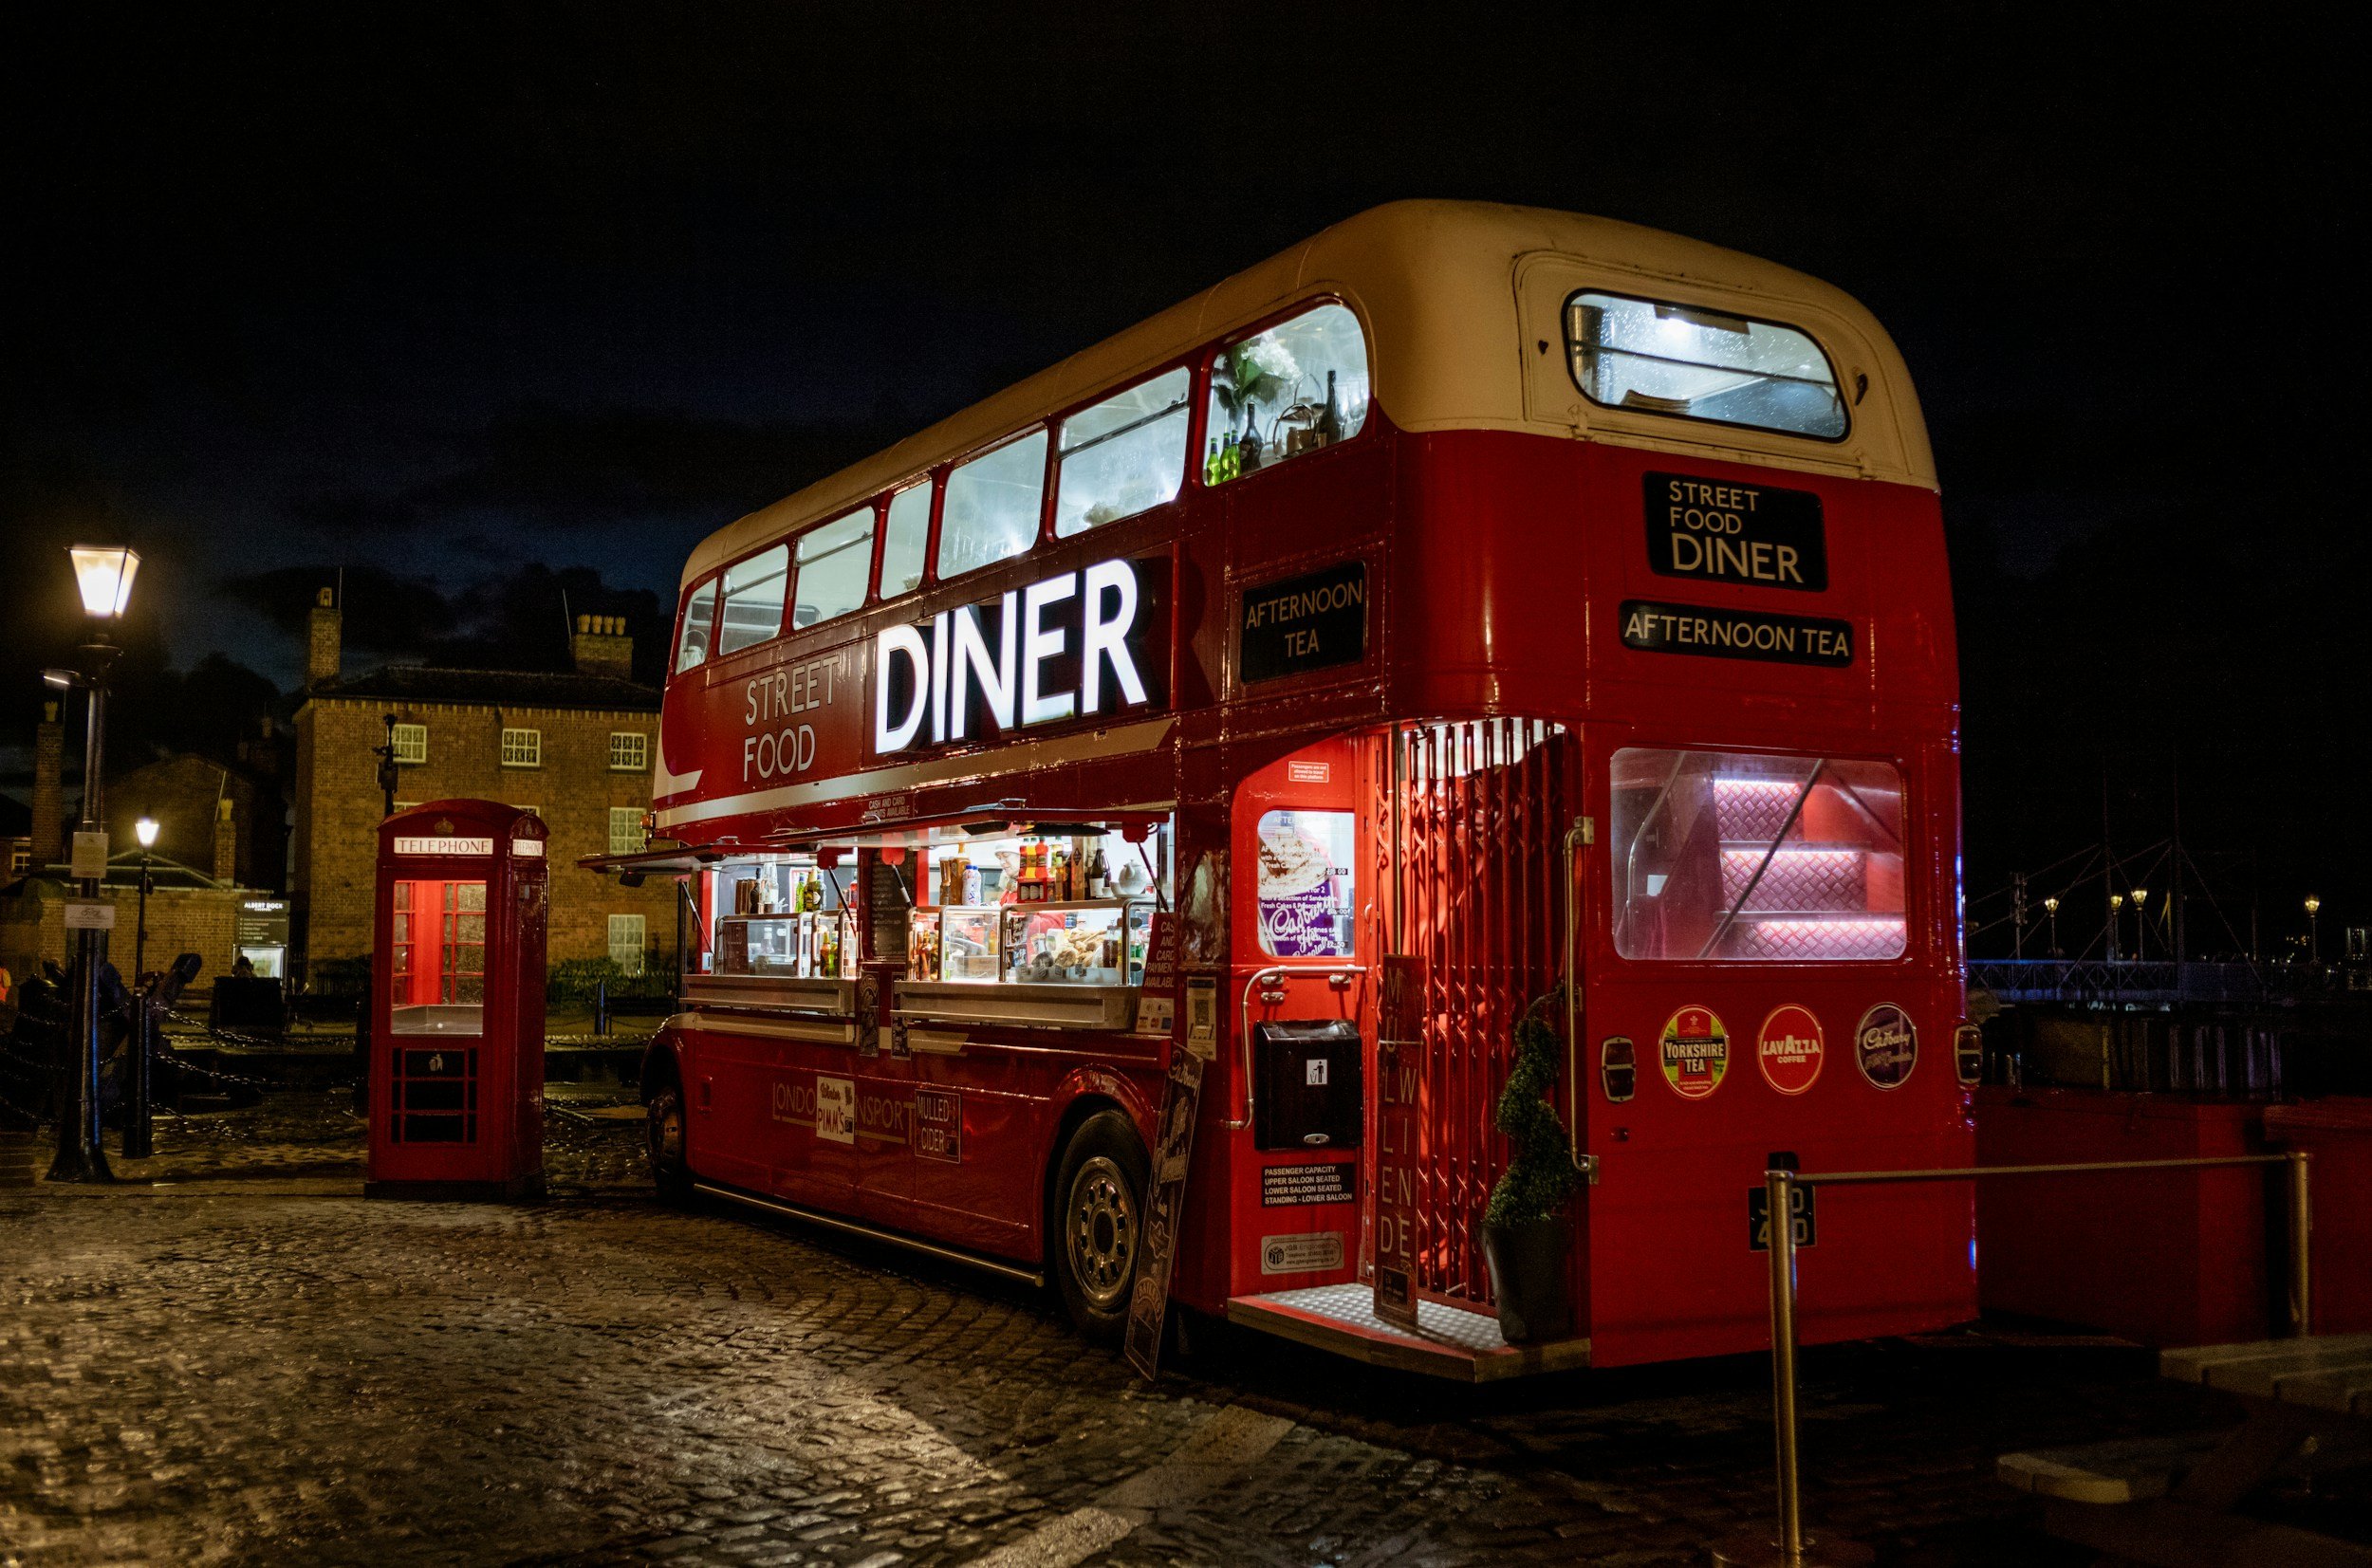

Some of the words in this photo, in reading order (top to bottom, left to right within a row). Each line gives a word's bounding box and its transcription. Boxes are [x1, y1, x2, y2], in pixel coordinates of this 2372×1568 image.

[1669, 480, 1760, 512] STREET
[1669, 507, 1742, 535] FOOD
[1671, 532, 1805, 584] DINER
[1246, 579, 1362, 630] AFTERNOON
[1285, 628, 1320, 658] TEA
[1624, 613, 1796, 652] AFTERNOON
[1802, 628, 1850, 657] TEA
[875, 558, 1148, 755] DINER
[745, 655, 840, 727] STREET
[743, 724, 816, 784] FOOD
[398, 840, 490, 854] TELEPHONE
[513, 840, 542, 855] TELEPHONE
[1665, 1042, 1725, 1059] YORKSHIRE
[1762, 1034, 1821, 1056] LAVAZZA
[1862, 1027, 1911, 1049] Cadbury
[1685, 1059, 1706, 1073] TEA
[1777, 1055, 1807, 1064] COFFEE
[771, 1081, 816, 1118] LONDO
[917, 1095, 950, 1123] MULLED
[817, 1105, 845, 1135] PIMM'S
[920, 1126, 945, 1153] CIDER
[1264, 1167, 1305, 1176] PASSENGER
[1305, 1165, 1336, 1174] CAPACITY
[1264, 1177, 1288, 1186] UPPER
[1288, 1176, 1315, 1185] SALOON
[1315, 1175, 1341, 1184] SEATED
[1264, 1187, 1288, 1195] LOWER
[1288, 1185, 1316, 1194] SALOON
[1317, 1184, 1343, 1192] SEATED
[1264, 1195, 1298, 1205] STANDING
[1302, 1194, 1325, 1203] LOWER
[1325, 1193, 1353, 1202] SALOON
